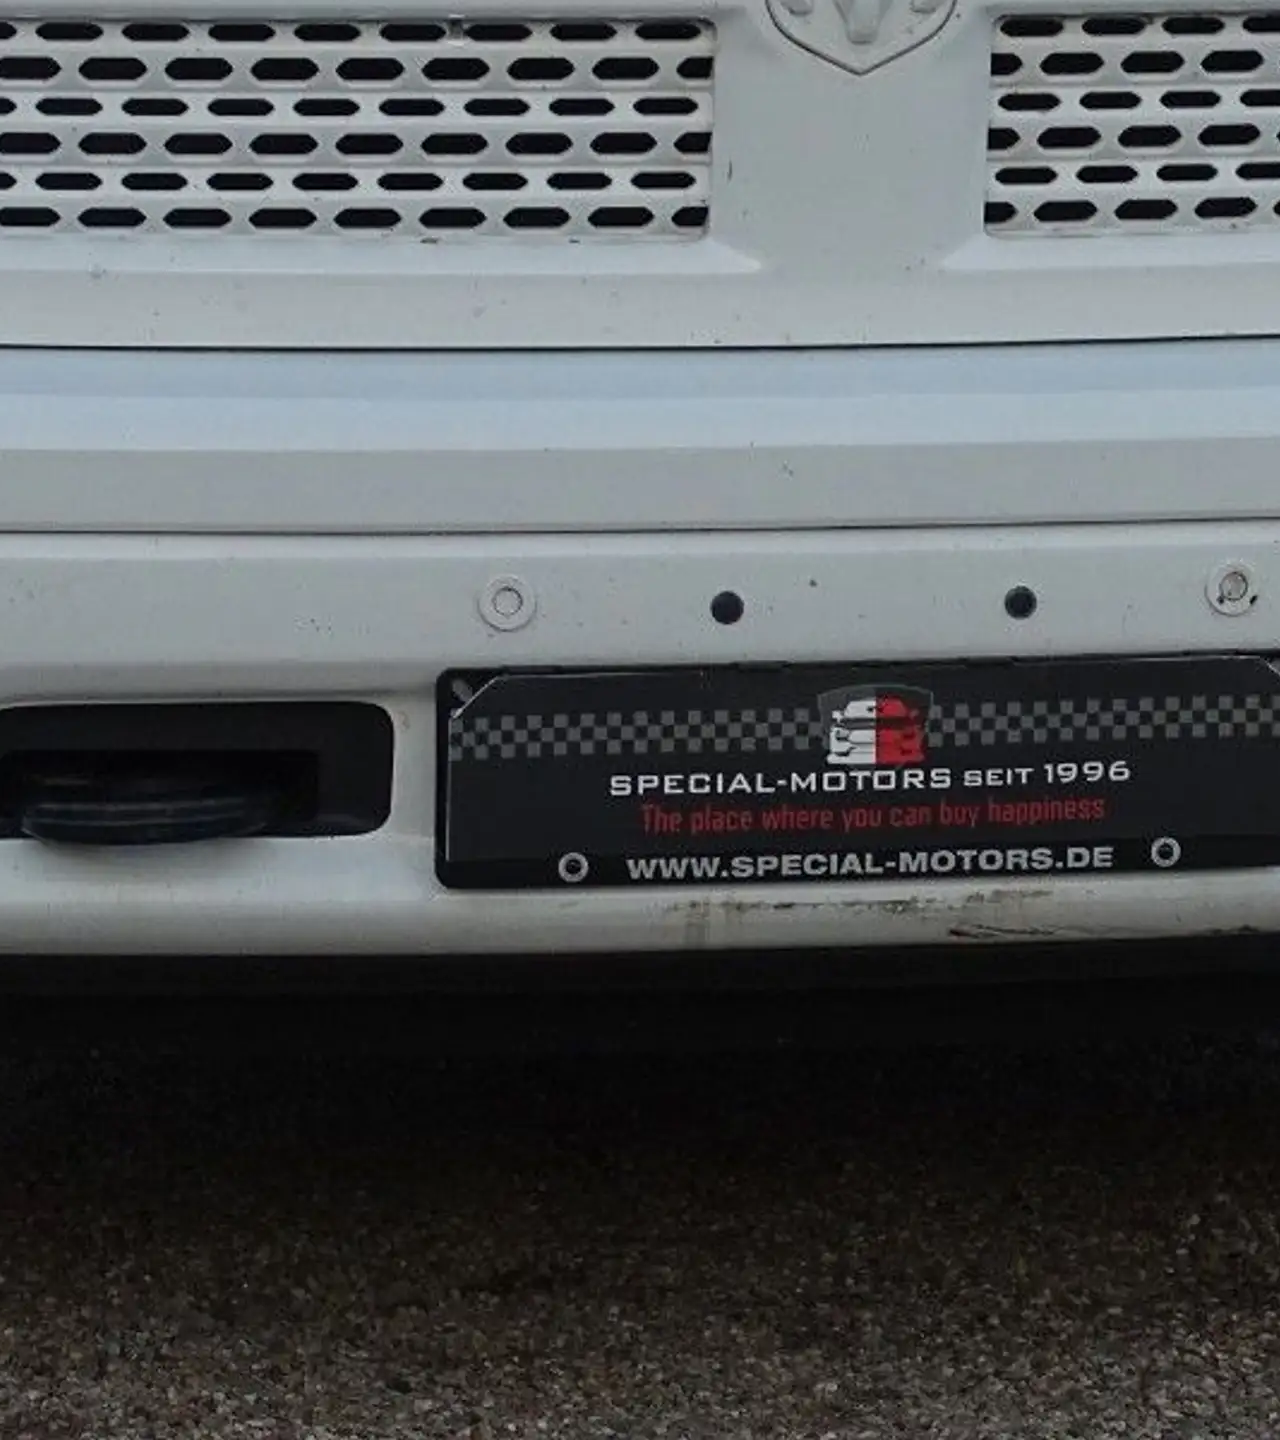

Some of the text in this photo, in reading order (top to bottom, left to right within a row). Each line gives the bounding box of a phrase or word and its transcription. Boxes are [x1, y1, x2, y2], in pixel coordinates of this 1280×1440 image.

[609, 759, 1132, 797] SPECIAL-MOTORS SEIT 1996
[642, 796, 1106, 835] The place where you can buy happiness
[625, 845, 1115, 880] WWW.SPECIAL-MOTORS.DE
